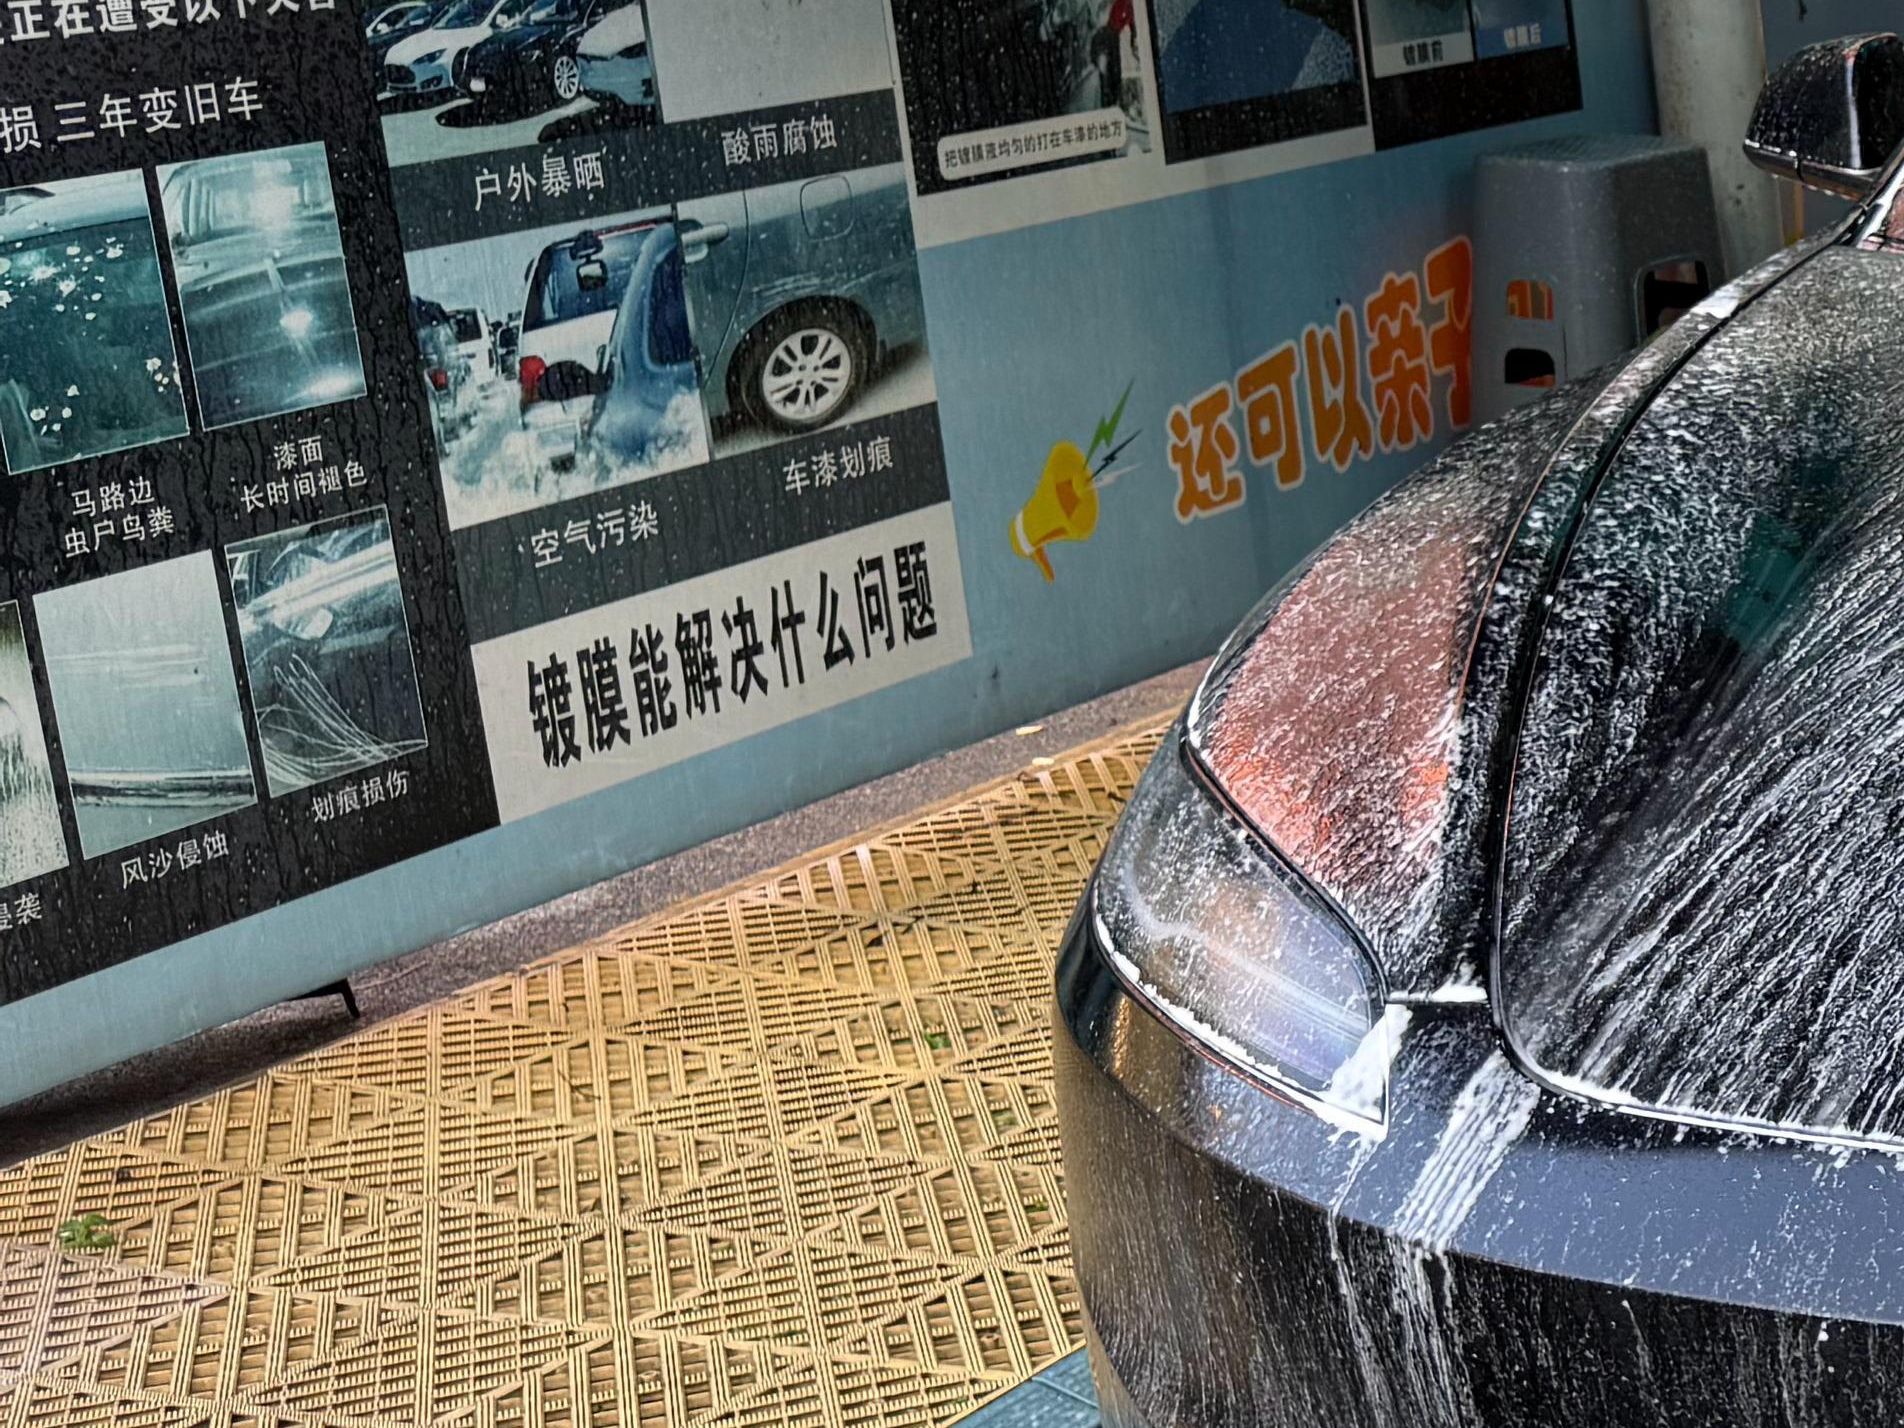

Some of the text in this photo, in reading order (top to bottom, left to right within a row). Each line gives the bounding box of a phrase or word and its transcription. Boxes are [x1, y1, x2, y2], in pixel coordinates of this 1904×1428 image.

[54, 76, 263, 142] 三年变旧车
[721, 113, 838, 166] 酸雨腐蚀
[474, 152, 605, 212] 户外暴晒
[273, 435, 323, 471] 漆面
[782, 435, 894, 496] 车漆划痕
[71, 475, 156, 520] 马路边
[240, 460, 368, 513] 长时间褪色
[530, 500, 659, 569] 空气污染
[527, 540, 938, 769] 镀膜能解决什么问题
[310, 769, 410, 823] 划痕损伤
[121, 829, 230, 890] 风沙侵蚀
